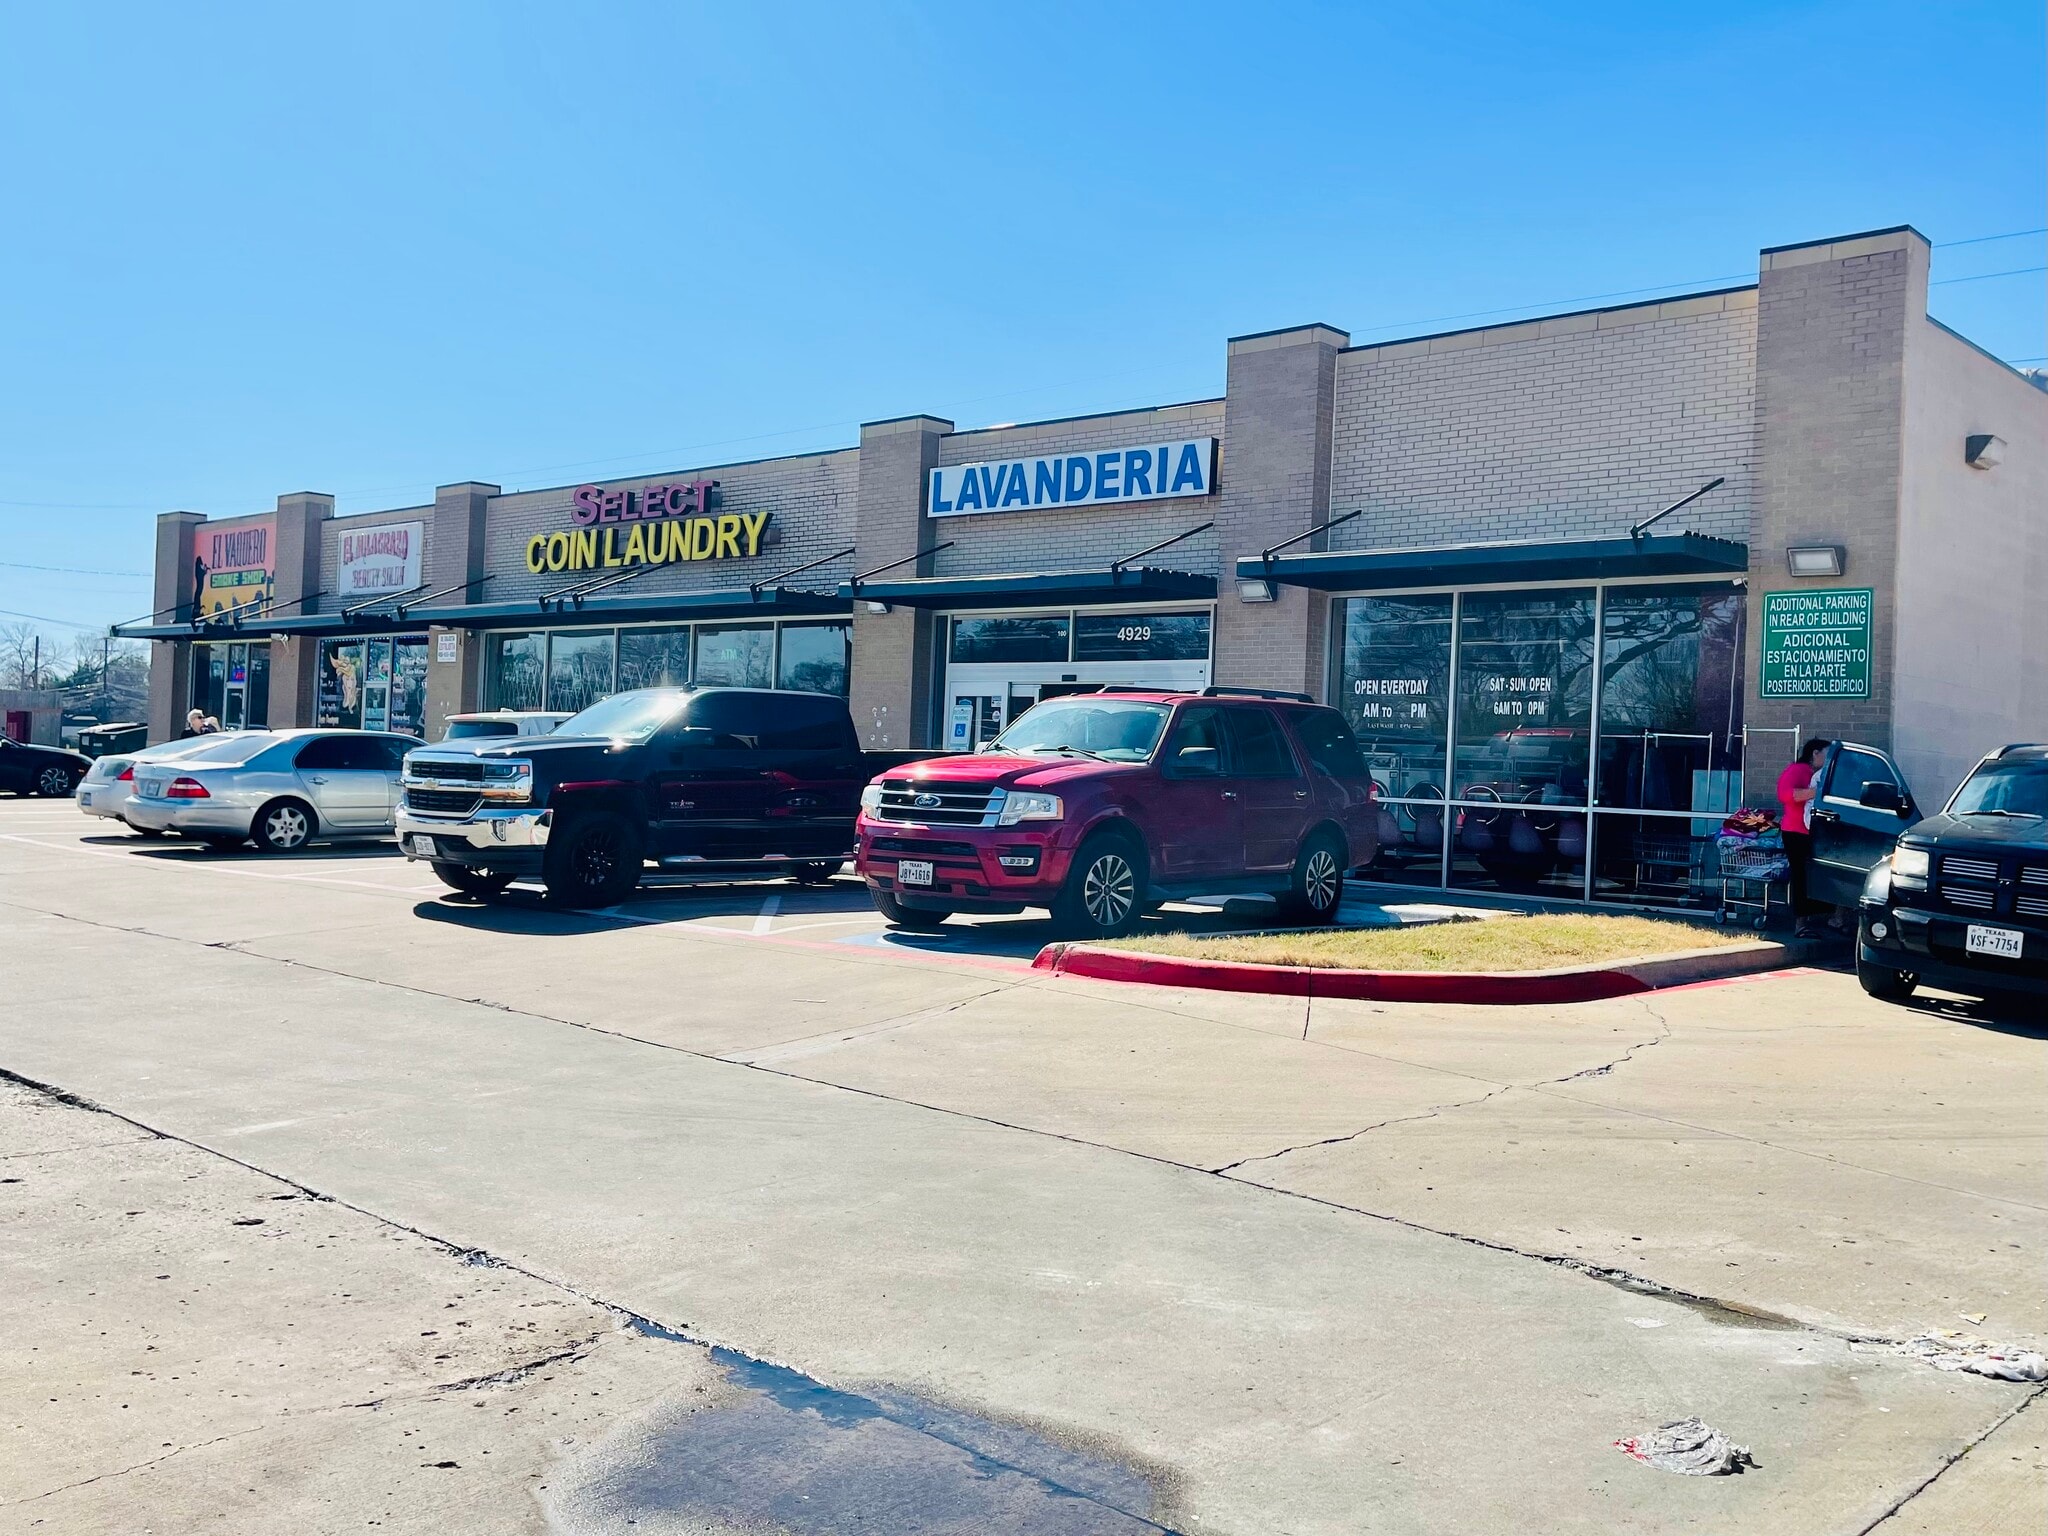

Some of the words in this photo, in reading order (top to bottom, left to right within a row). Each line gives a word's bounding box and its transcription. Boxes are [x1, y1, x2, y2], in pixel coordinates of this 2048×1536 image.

[932, 443, 1204, 513] LAVANDERIA
[572, 480, 718, 525] SELECT
[212, 534, 222, 569] EL
[225, 528, 267, 568] VAQUERO
[526, 528, 598, 574] COIN
[604, 512, 770, 567] LAUNDRY
[212, 572, 239, 588] SMOKE
[241, 570, 265, 585] SHOP
[353, 568, 380, 589] BEAUTY
[1770, 597, 1824, 611] ADDITIONAL
[1825, 595, 1867, 610] PARKING
[1769, 614, 1778, 627] IN
[1780, 613, 1805, 626] REAR
[1807, 612, 1820, 626] OF
[1821, 611, 1866, 626] BUILDING
[1117, 626, 1151, 641] 4929
[1783, 633, 1850, 648] ADICIONAL
[721, 648, 738, 660] ATM
[1767, 649, 1866, 664] ESTACIONAMIENTO
[1784, 664, 1797, 678] EN
[1799, 664, 1812, 677] LA
[1814, 663, 1847, 677] PARTE
[1354, 679, 1379, 695] OPEN
[1381, 679, 1429, 695] EVERYDAY
[1529, 677, 1551, 692] OPEN
[1767, 679, 1811, 693] POSTERIOR
[1812, 679, 1828, 693] DEL
[1829, 678, 1864, 693] EDIFICIO
[1363, 703, 1379, 718] AM
[1410, 703, 1427, 718] PM
[1493, 701, 1510, 715] 6AM
[1511, 701, 1523, 715] TO
[1985, 929, 2006, 937] TEXAS
[1970, 934, 2019, 952] VSF-7754
